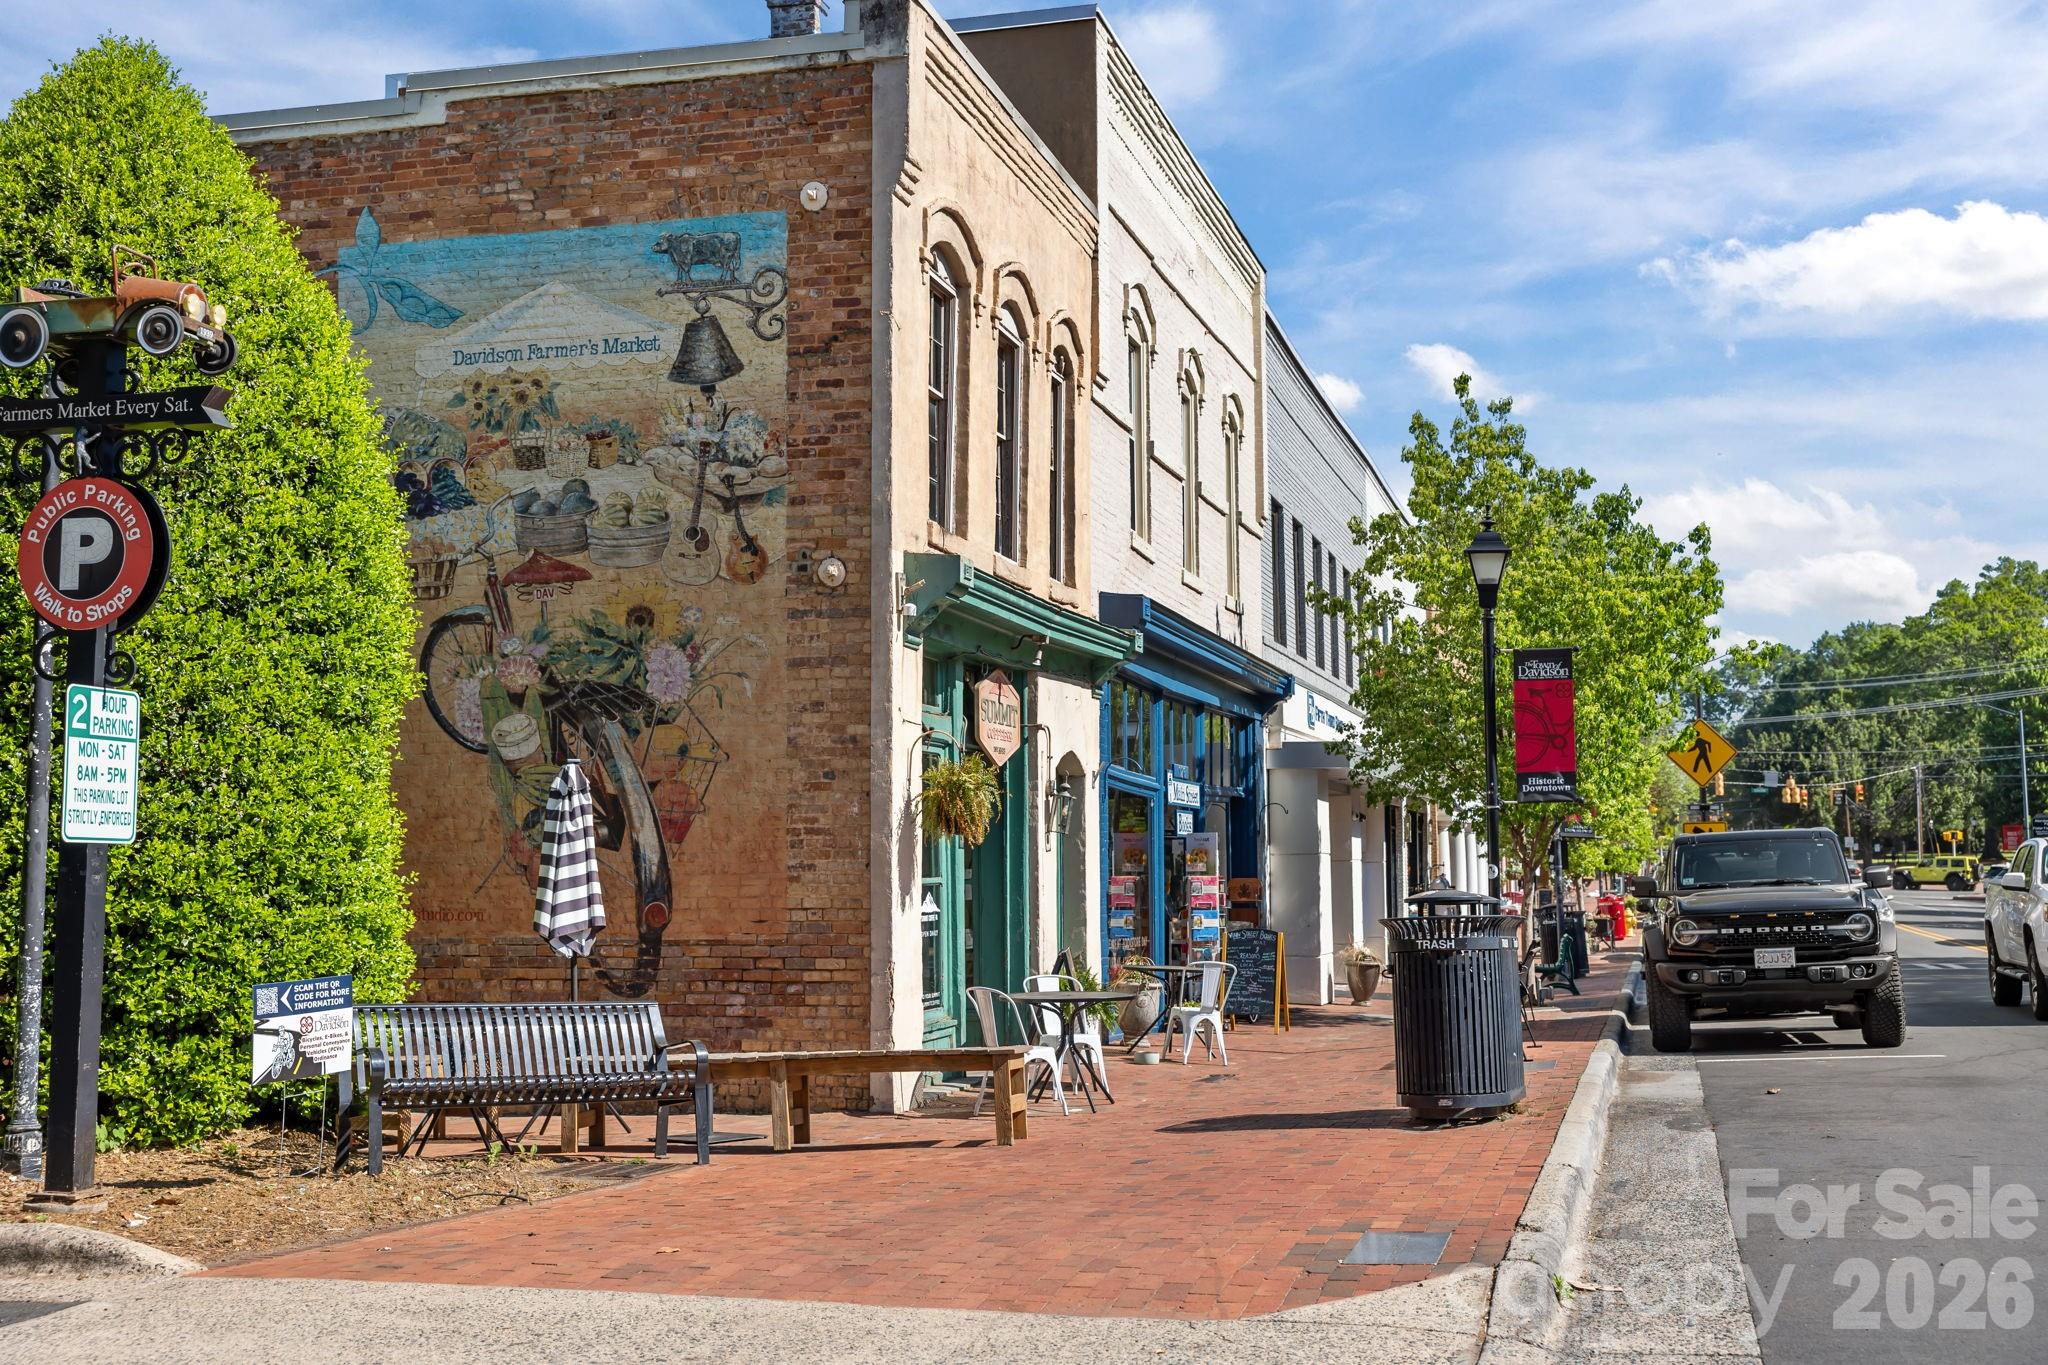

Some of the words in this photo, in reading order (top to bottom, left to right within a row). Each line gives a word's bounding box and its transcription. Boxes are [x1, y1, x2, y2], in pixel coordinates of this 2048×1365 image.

[452, 348, 524, 366] Davidson
[526, 339, 599, 361] Farmer's
[601, 335, 660, 355] Market
[57, 401, 110, 419] Market
[115, 399, 159, 418] Every
[164, 396, 193, 413] Sat.
[27, 491, 77, 543] Public
[84, 484, 141, 541] Parking
[59, 517, 114, 590] P
[33, 582, 66, 618] Walk
[67, 607, 82, 622] to
[86, 585, 132, 621] Shops
[535, 588, 554, 599] DAV
[1518, 665, 1569, 677] Davidson
[1530, 660, 1554, 669] Town
[71, 693, 88, 729] 2
[101, 695, 127, 714] HOUR
[980, 699, 1018, 728] SUMMIT
[93, 716, 133, 736] PARKING
[78, 741, 99, 758] MON
[108, 744, 126, 760] SAT
[77, 764, 98, 781] 8AM
[107, 767, 126, 783] 5PM
[1528, 776, 1565, 785] Historic
[73, 787, 88, 803] THIS
[88, 789, 115, 804] PARKING
[116, 790, 128, 805] LOT
[1522, 784, 1571, 793] Downtown
[67, 808, 98, 825] STRICTLY
[100, 810, 131, 826] ENFORCED
[1721, 925, 1824, 934] BRONCO
[1416, 939, 1455, 949] TRASH
[294, 983, 314, 992] SCAN
[315, 981, 329, 990] THE
[330, 980, 340, 989] QR
[294, 992, 314, 1001] CODE
[315, 990, 329, 998] FOR
[330, 987, 350, 997] MORE
[294, 997, 344, 1010] INFORMATION
[314, 1020, 349, 1032] Davidson
